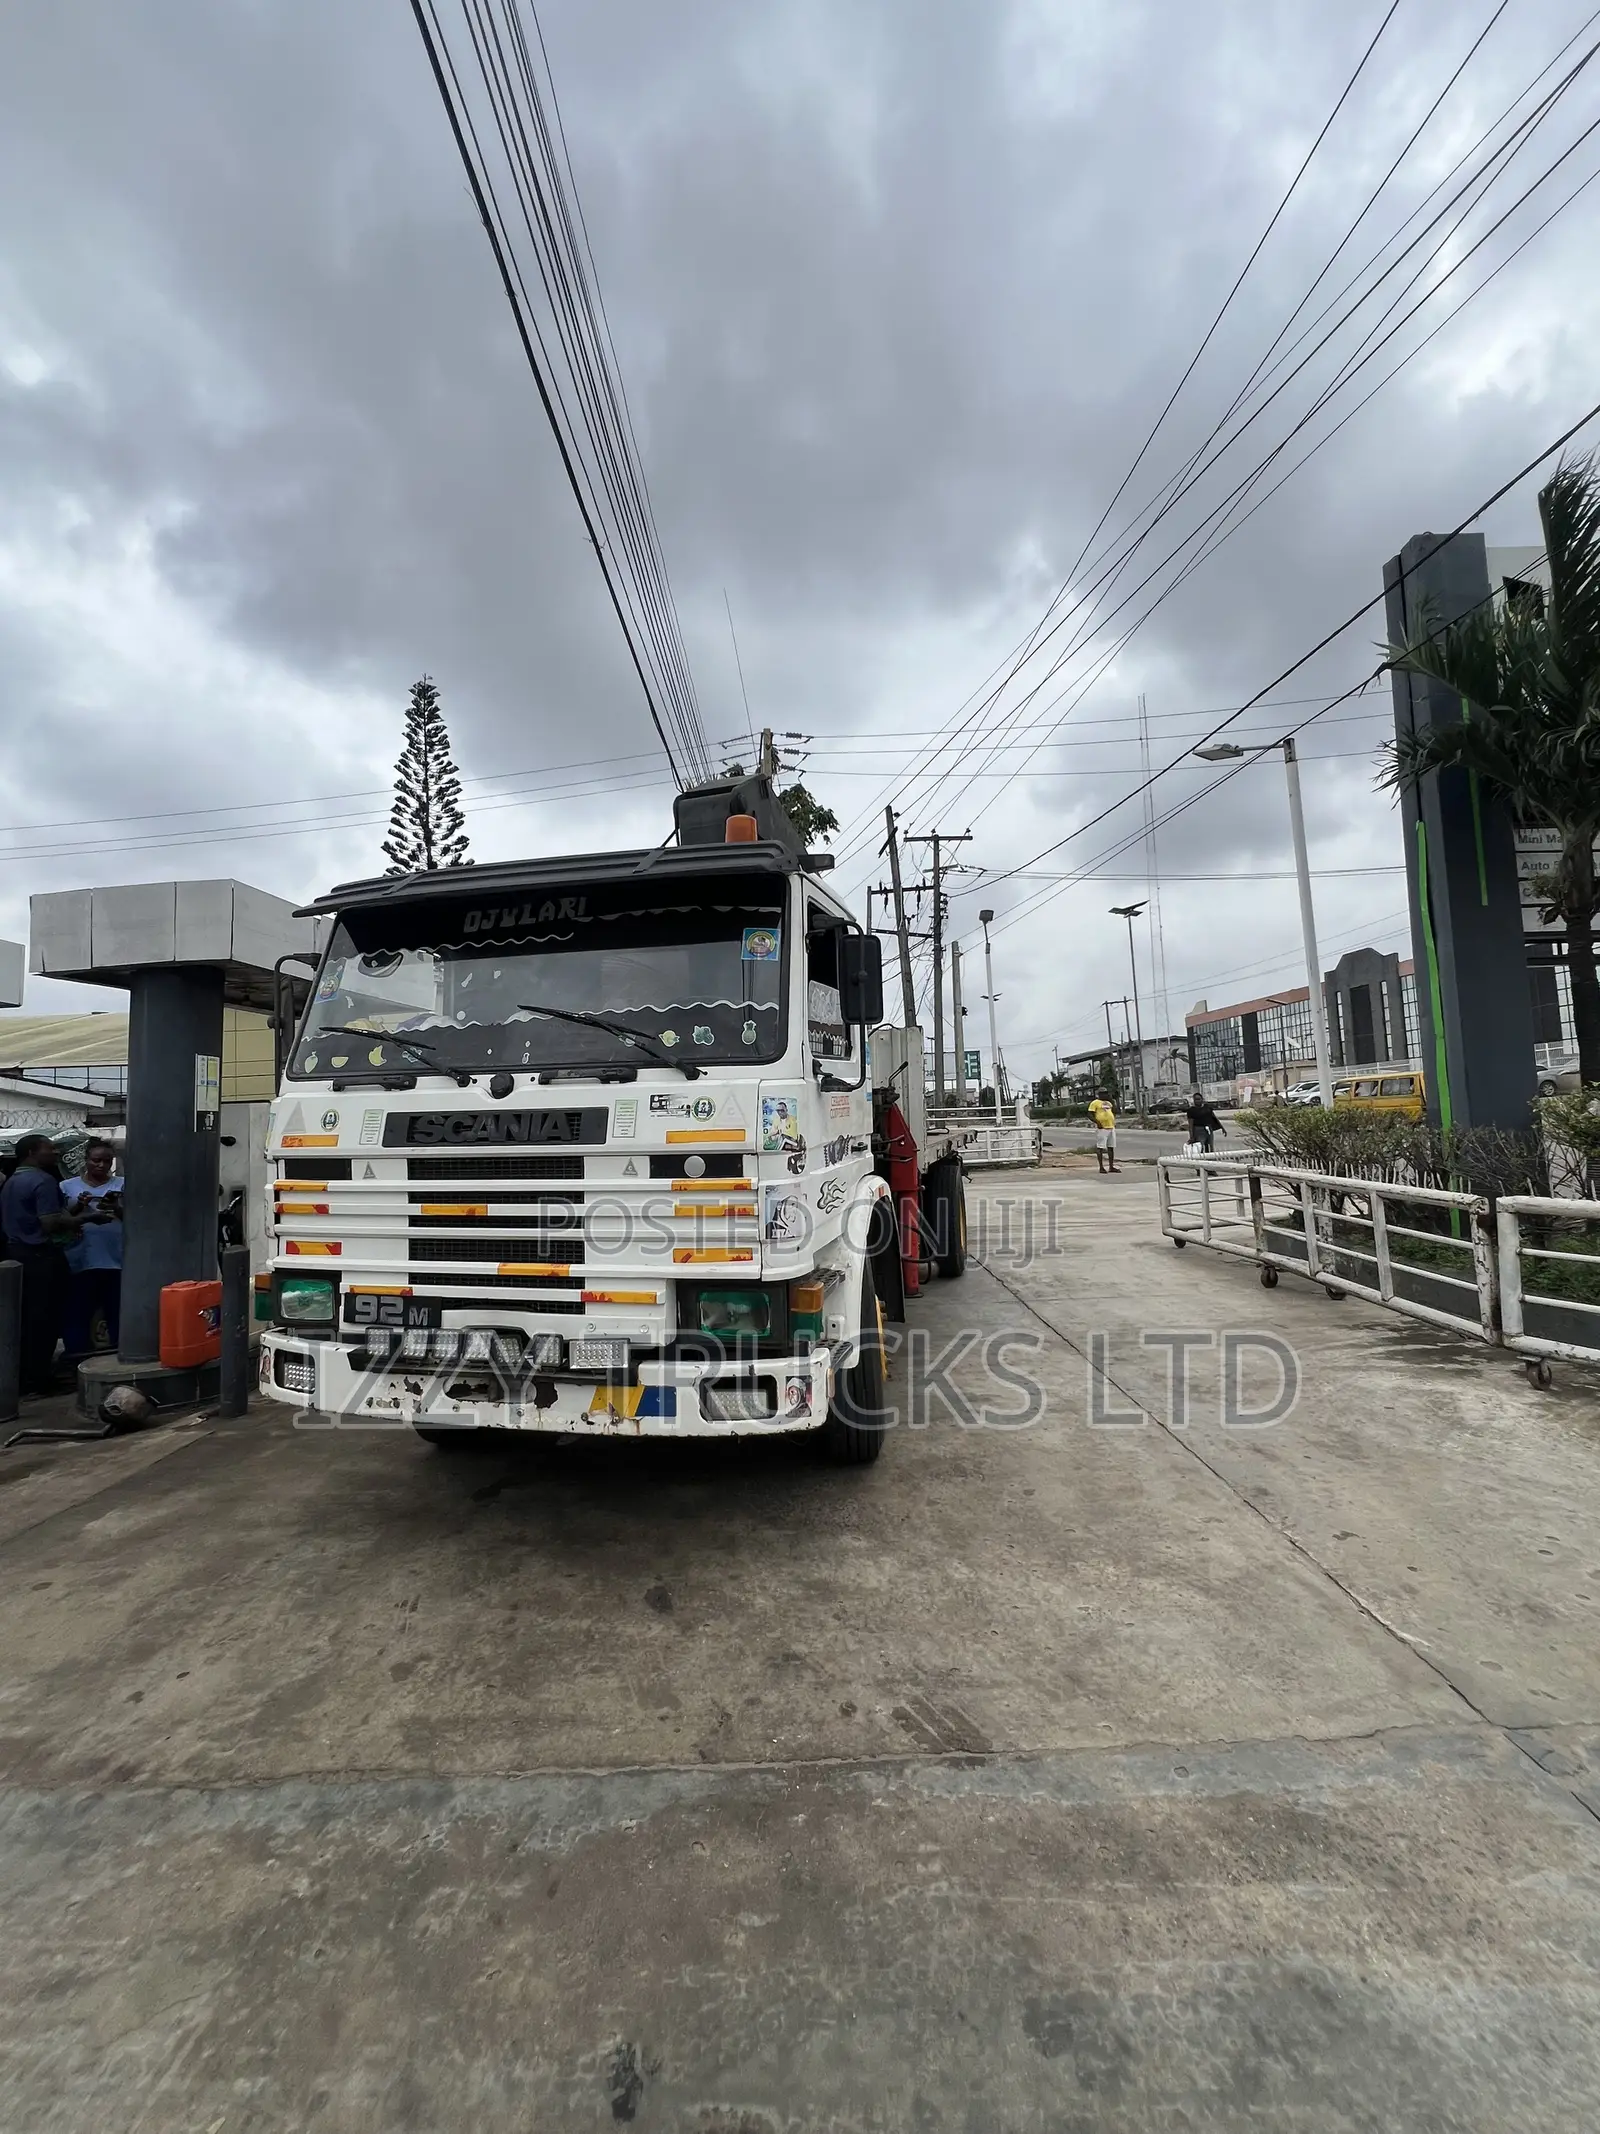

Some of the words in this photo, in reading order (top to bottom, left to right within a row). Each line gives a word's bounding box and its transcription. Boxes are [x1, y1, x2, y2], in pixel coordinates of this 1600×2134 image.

[1521, 861, 1550, 871] Auto
[411, 1112, 573, 1144] SCANIA
[354, 1294, 404, 1325] 92
[408, 1307, 429, 1326] M
